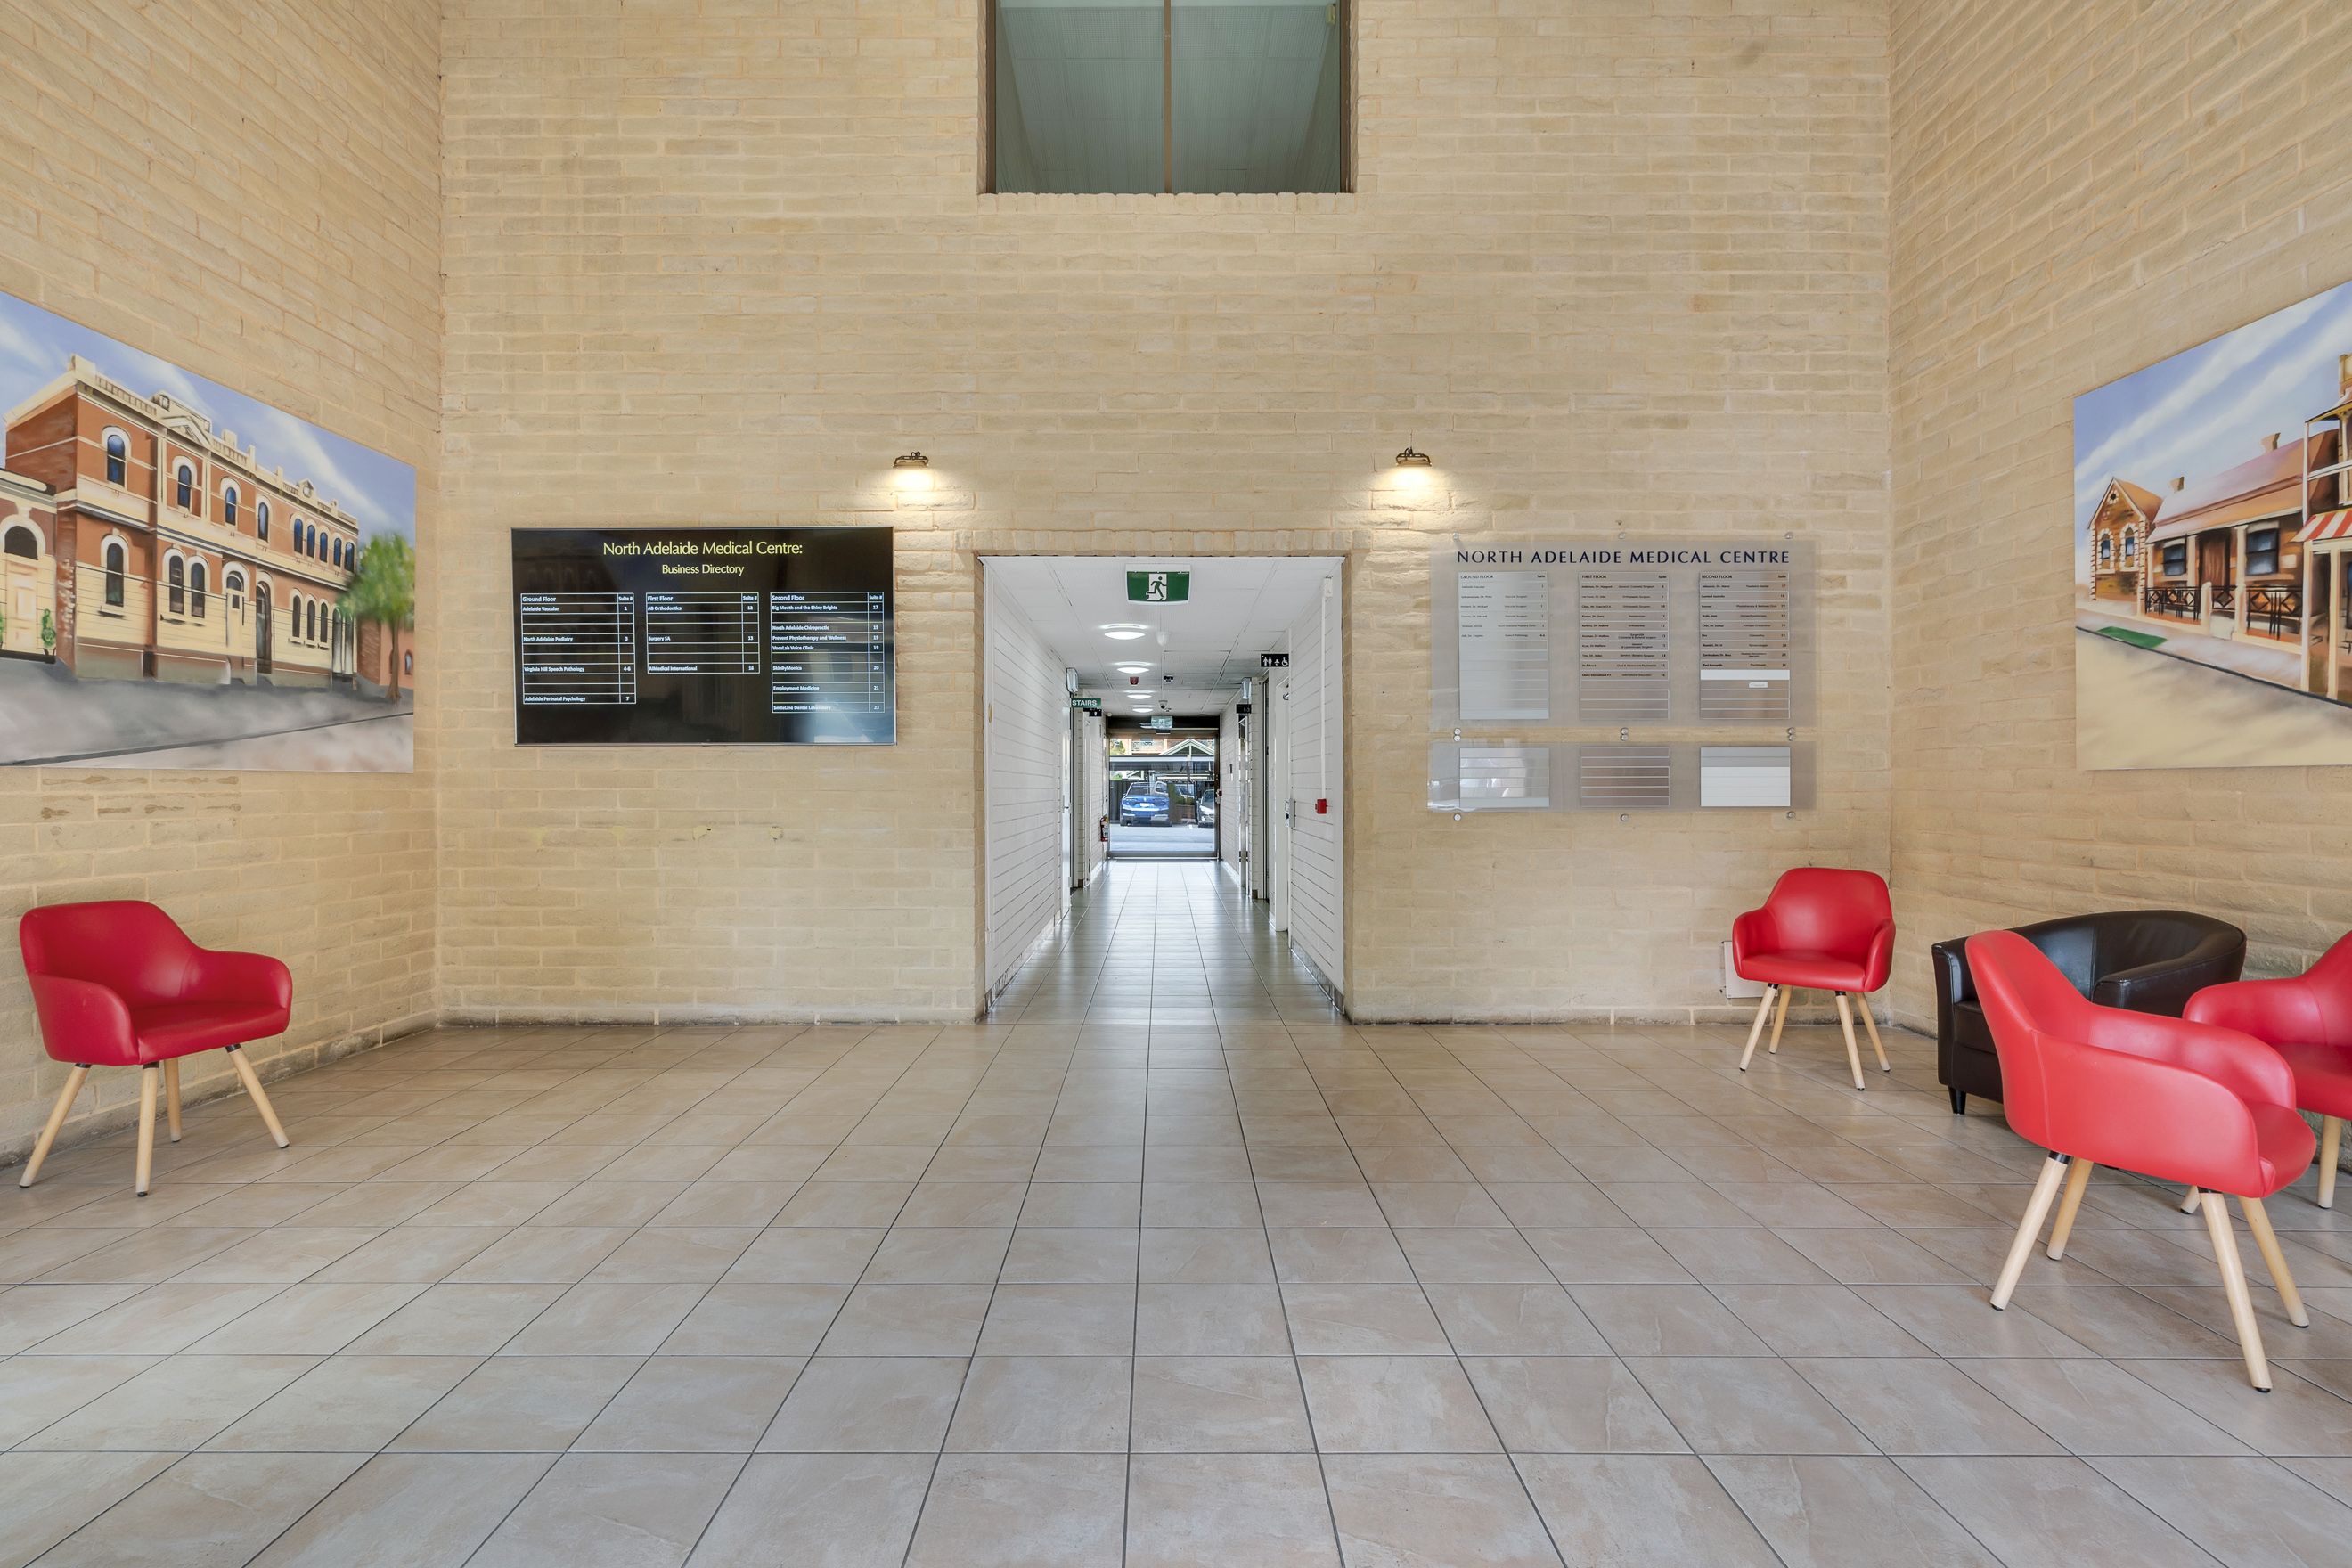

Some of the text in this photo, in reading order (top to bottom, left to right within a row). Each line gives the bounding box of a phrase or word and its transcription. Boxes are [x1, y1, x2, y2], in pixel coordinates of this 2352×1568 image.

[603, 541, 803, 555] North Adelaide Medical Centre:
[1458, 551, 1790, 563] NORTH ADELAIDE MEDICAL CENTRE
[662, 564, 744, 576] Business Directory
